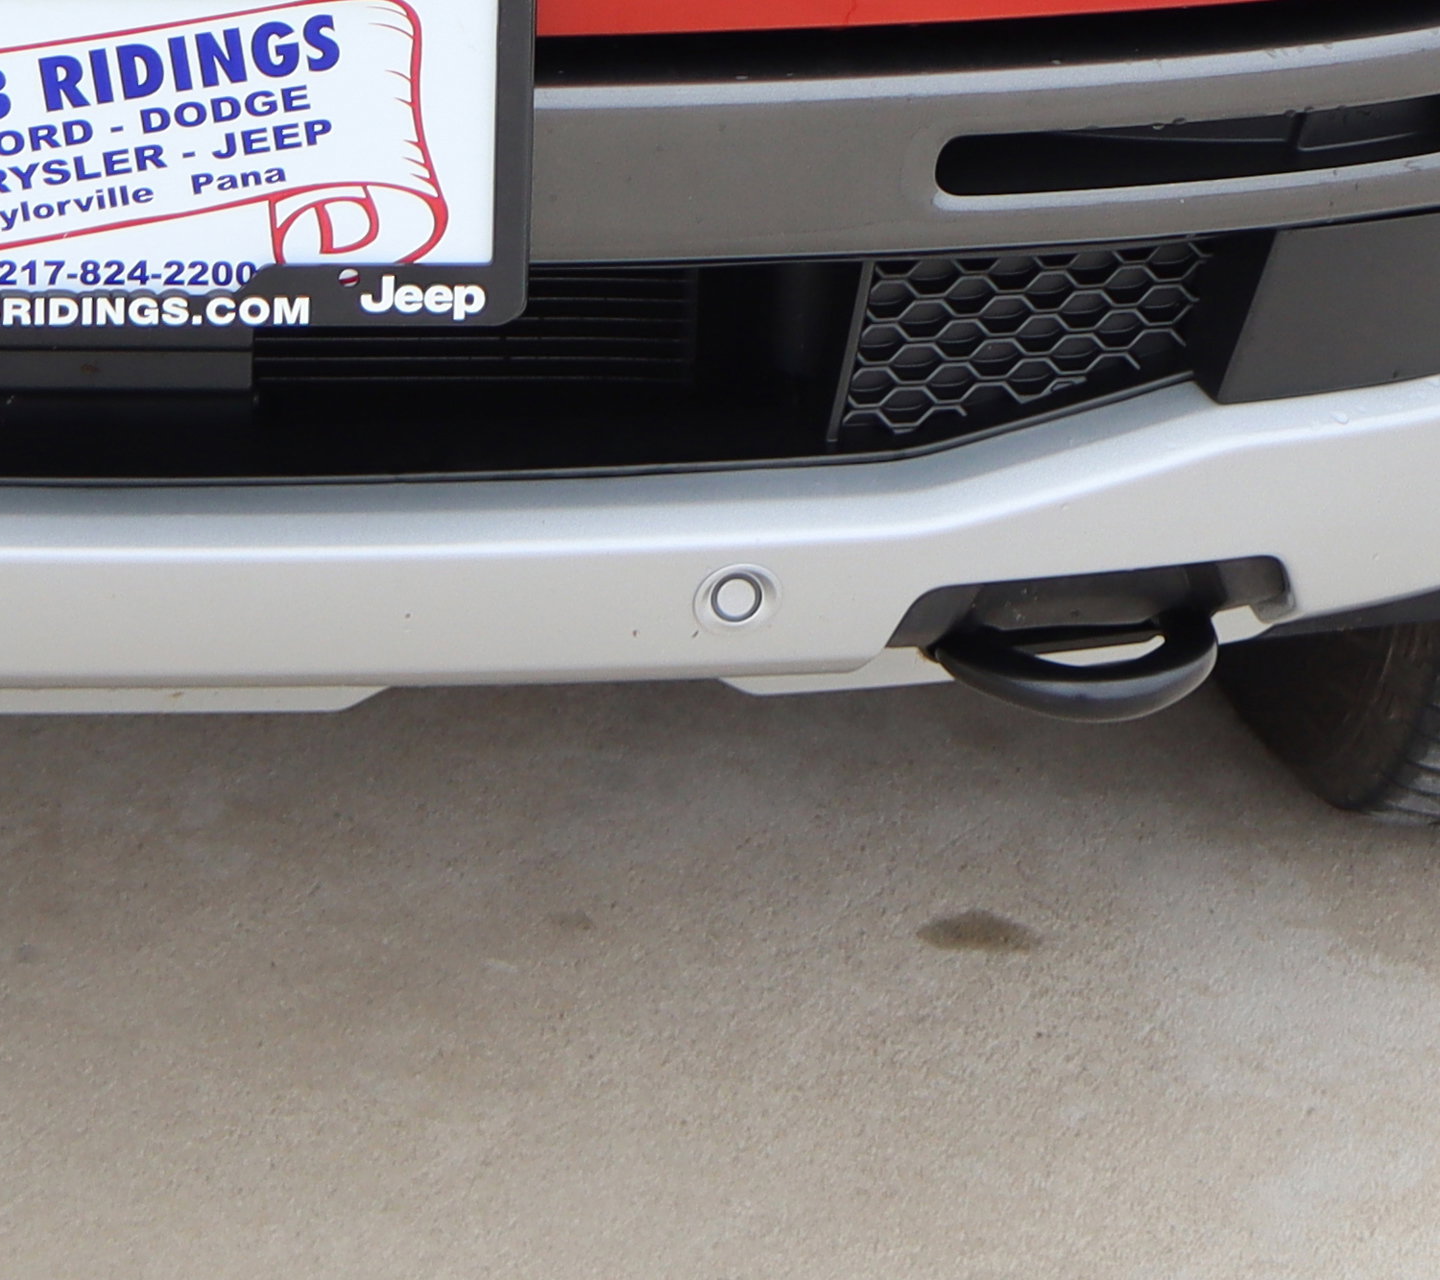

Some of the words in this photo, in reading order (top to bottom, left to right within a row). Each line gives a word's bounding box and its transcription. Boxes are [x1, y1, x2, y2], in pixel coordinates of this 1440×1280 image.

[38, 13, 341, 113] RIDINGS
[140, 84, 311, 134] DODGE
[212, 118, 333, 160] JEEP
[191, 166, 287, 195] Pana
[360, 274, 486, 321] Jeep
